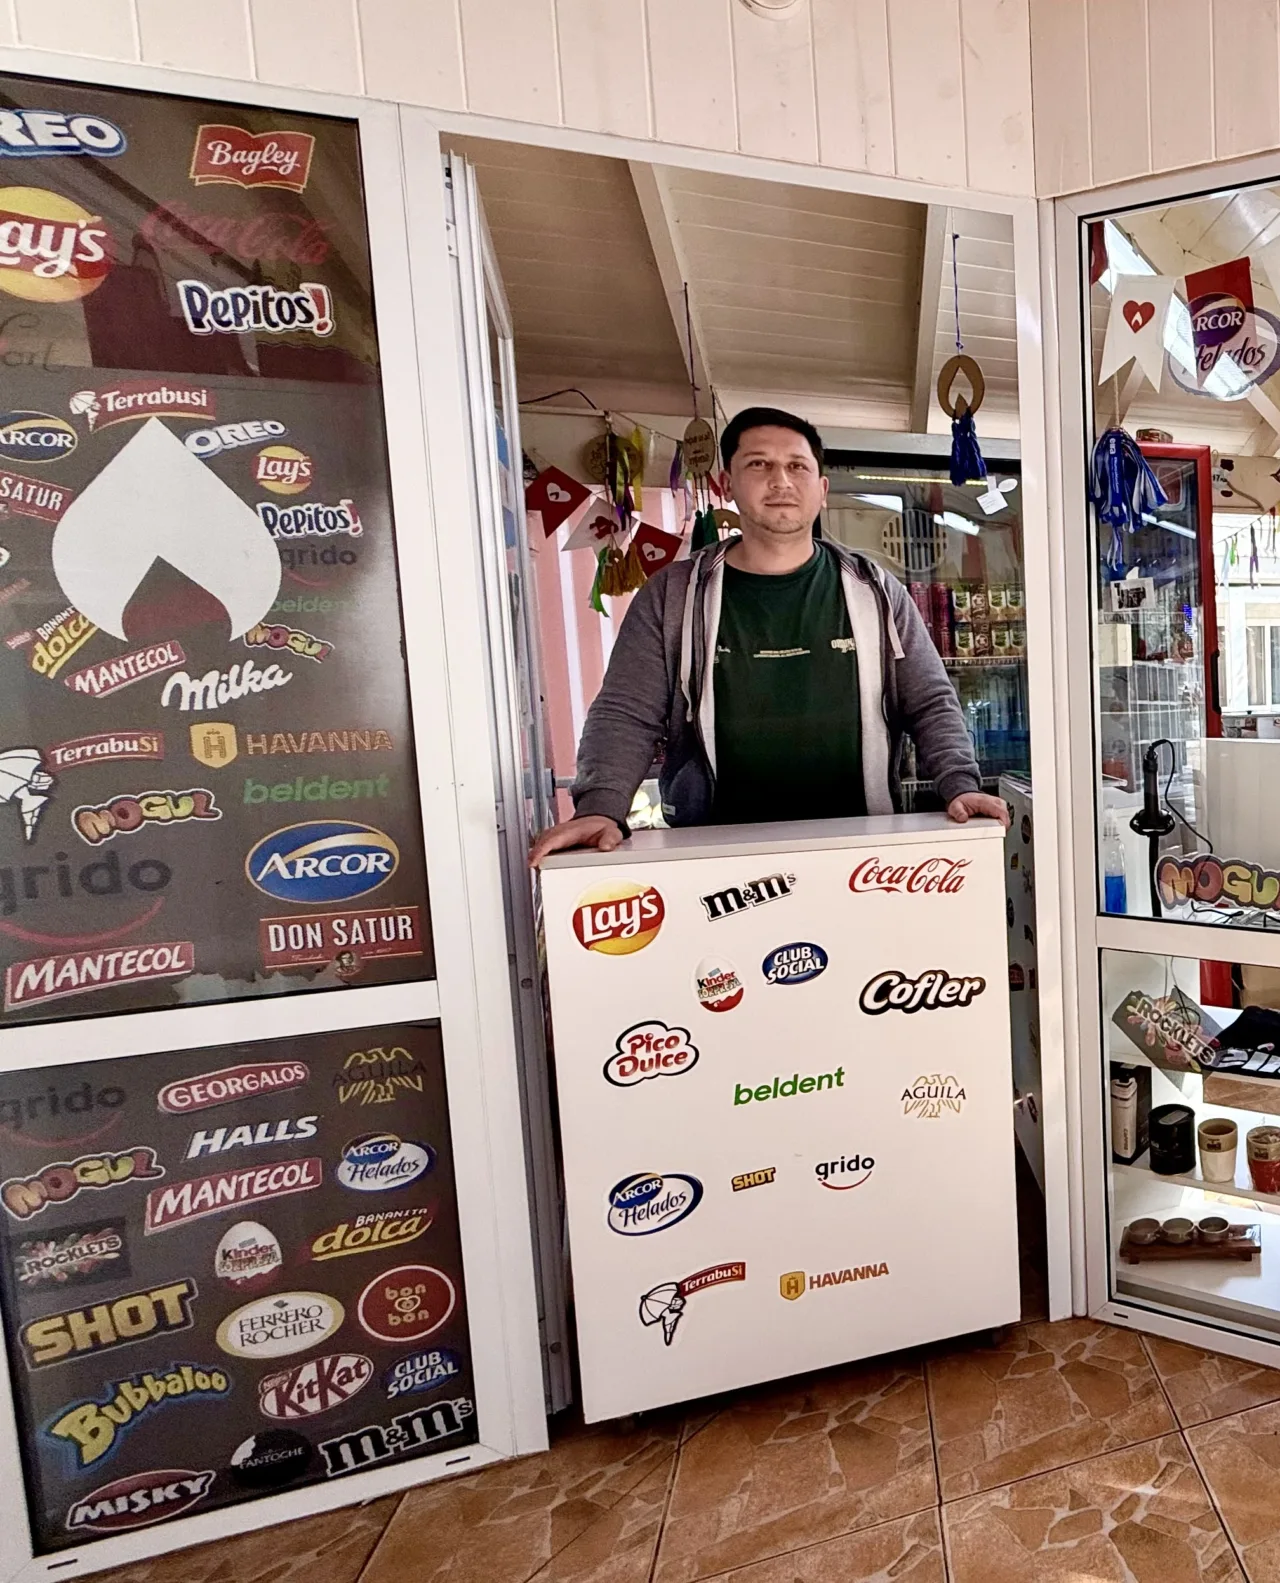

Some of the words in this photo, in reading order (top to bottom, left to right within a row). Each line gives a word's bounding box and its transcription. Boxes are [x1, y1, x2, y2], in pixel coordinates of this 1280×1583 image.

[206, 140, 301, 176] Bagley
[0, 219, 107, 278] ay's
[181, 282, 332, 334] Pepitos!
[104, 387, 208, 411] Terrabusi
[184, 418, 287, 456] OREO
[257, 455, 312, 484] Lay's
[260, 499, 362, 537] Pepitos!
[73, 642, 179, 694] MANTECOL
[161, 659, 293, 710] Milka
[247, 730, 393, 754] HAVANNA
[243, 773, 391, 804] beldent
[76, 791, 219, 845] MOGUL
[257, 851, 392, 883] ARCOR
[268, 922, 324, 952] DON
[333, 915, 413, 946] SATUR
[581, 892, 659, 942] Lay's
[15, 945, 186, 998] MANTECOL
[767, 958, 825, 984] SOCIAL
[773, 946, 813, 967] CLUB
[860, 972, 983, 1011] Cofler
[627, 1033, 681, 1053] Pico
[1136, 997, 1218, 1066] ROCKLETS
[616, 1048, 688, 1077] Dulce
[167, 1063, 306, 1107] GEORGALOS
[733, 1066, 846, 1106] beldent
[901, 1084, 967, 1101] AGUILA
[187, 1115, 320, 1158] HALLS
[344, 1140, 399, 1157] ARCOR
[3, 1149, 162, 1216] MOGUL
[348, 1153, 421, 1184] Helados
[731, 1167, 776, 1191] SHOT
[814, 1154, 875, 1181] grido
[154, 1162, 314, 1224] MANTECOL
[613, 1178, 662, 1202] ARCOR
[355, 1206, 429, 1227] BANANITA
[618, 1191, 687, 1228] Helados
[27, 1234, 122, 1274] ROCKLETS
[312, 1216, 424, 1255] dolca
[385, 1283, 427, 1300] bon
[809, 1262, 889, 1290] HAVANNA
[25, 1283, 189, 1363] SHOT
[238, 1304, 323, 1334] FERRERO
[240, 1320, 326, 1348] ROCHER
[387, 1309, 429, 1326] bon
[386, 1362, 459, 1399] SOCIAL
[394, 1350, 442, 1377] CLUB
[51, 1365, 228, 1466] Bubbaloo
[72, 1470, 214, 1524] MISKY
